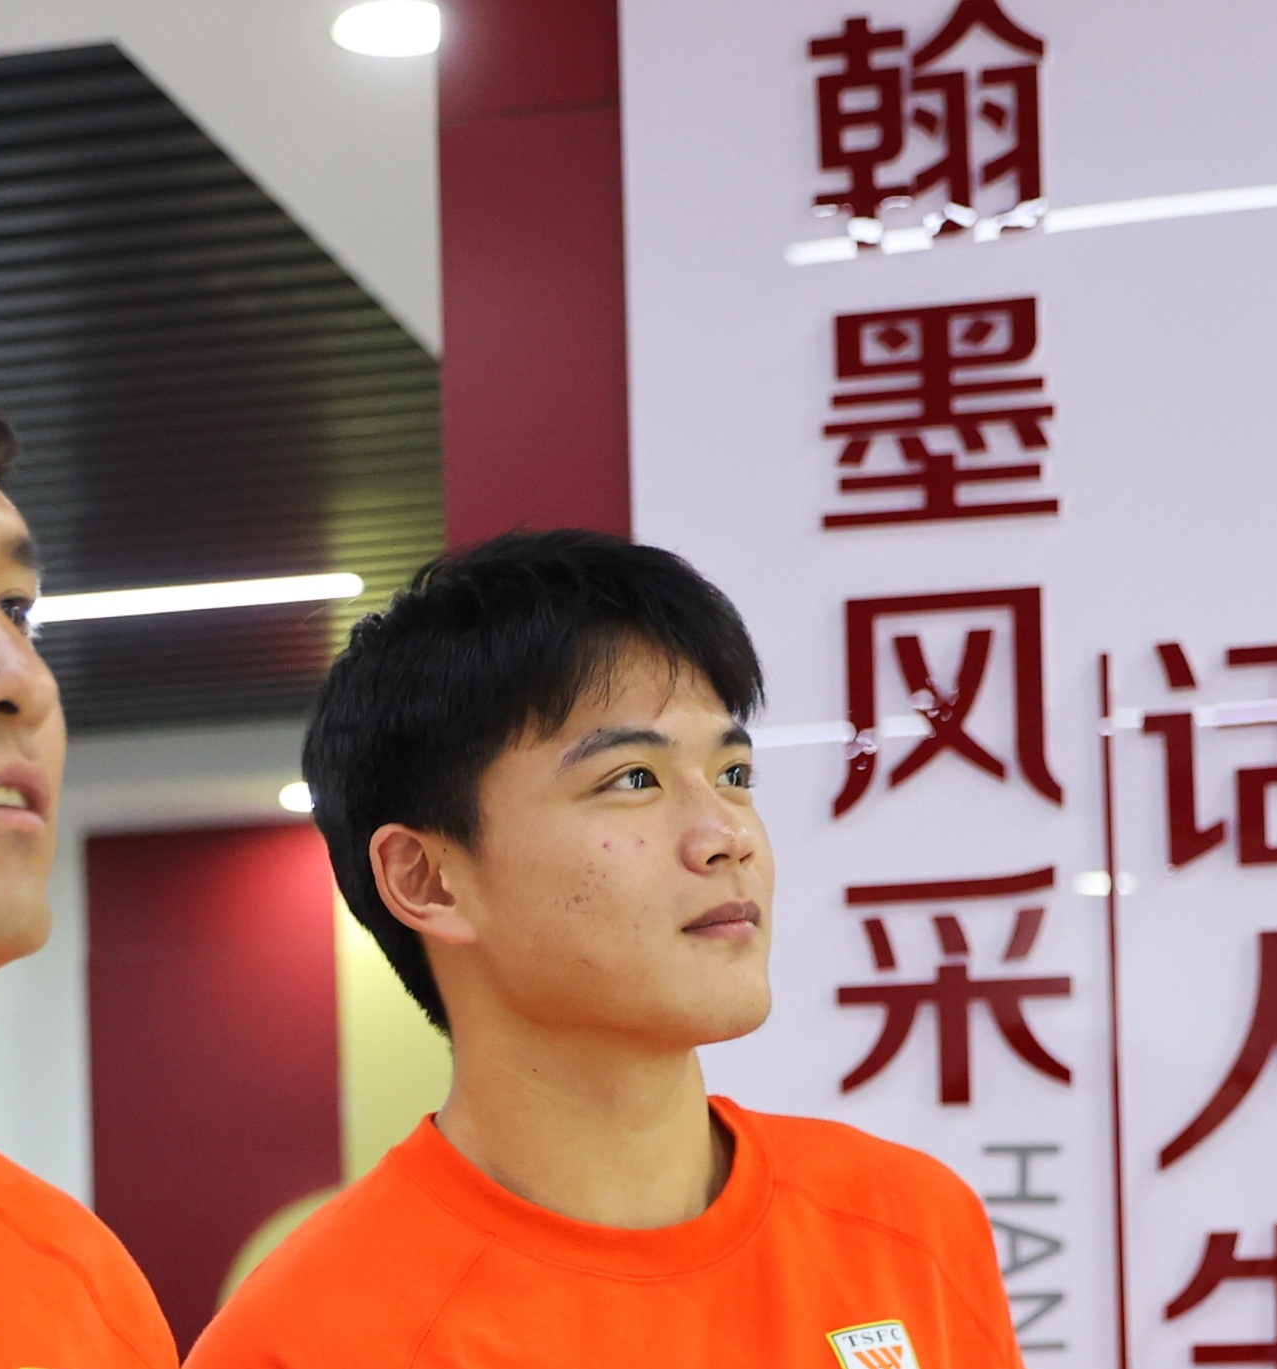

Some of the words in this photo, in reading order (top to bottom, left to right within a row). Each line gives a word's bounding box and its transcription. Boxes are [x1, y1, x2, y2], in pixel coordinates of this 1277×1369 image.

[808, 0, 1073, 1106] 翰墨风采
[842, 1328, 902, 1347] TSFC
